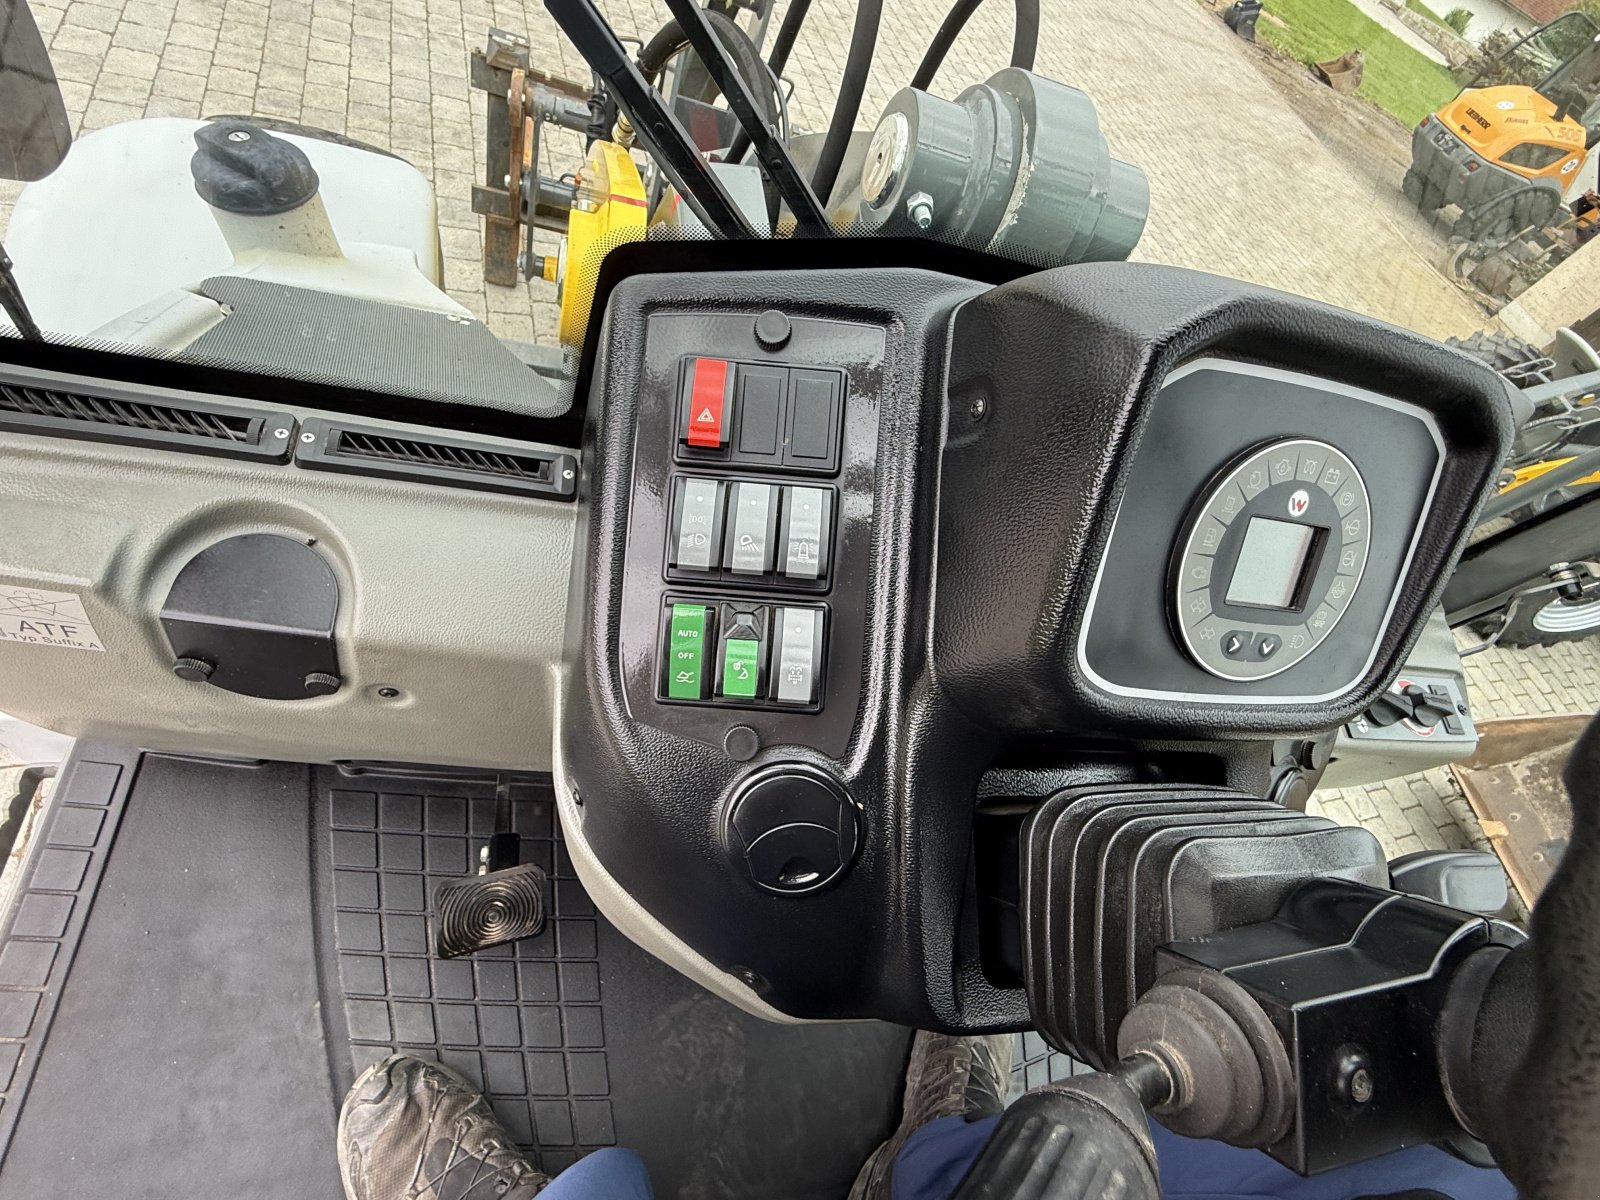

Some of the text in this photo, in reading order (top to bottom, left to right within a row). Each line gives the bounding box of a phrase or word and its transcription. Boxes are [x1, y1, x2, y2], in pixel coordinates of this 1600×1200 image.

[20, 620, 78, 637] ATF
[677, 629, 698, 638] AUTO
[8, 631, 38, 642] Typ
[42, 636, 85, 648] Suffix
[677, 652, 695, 660] OFF
